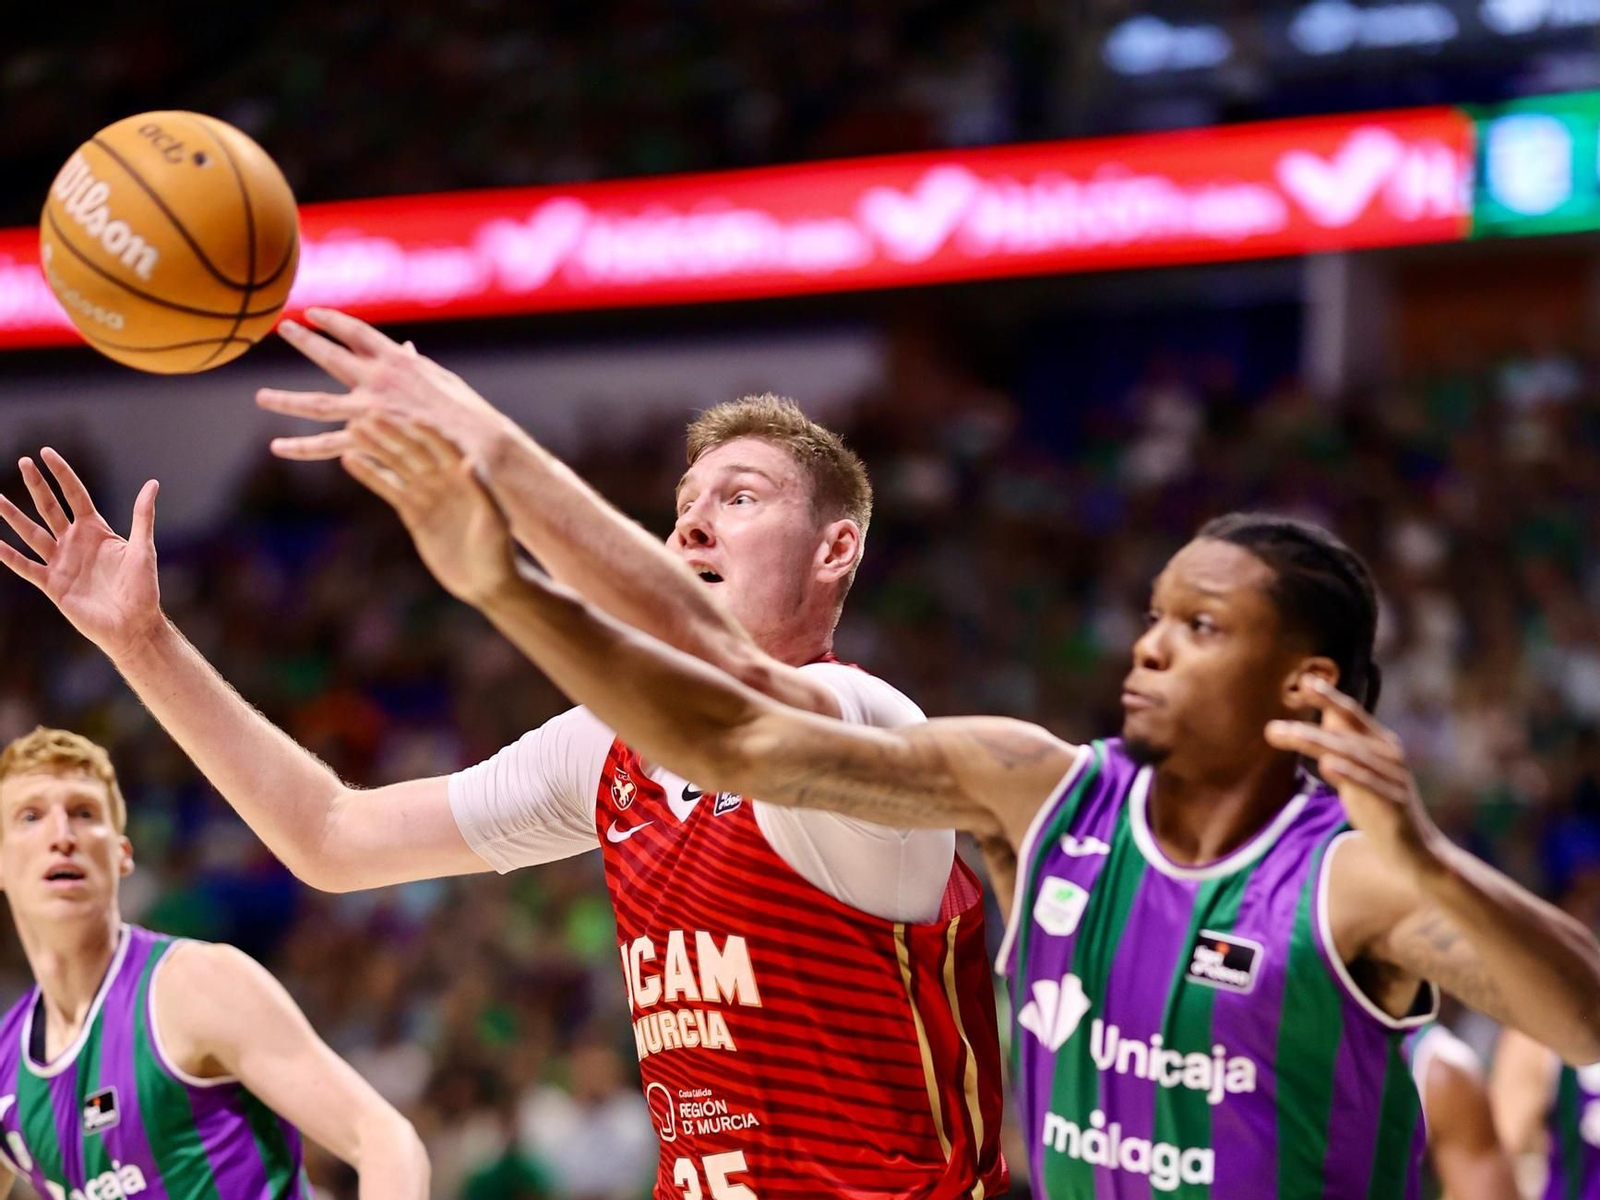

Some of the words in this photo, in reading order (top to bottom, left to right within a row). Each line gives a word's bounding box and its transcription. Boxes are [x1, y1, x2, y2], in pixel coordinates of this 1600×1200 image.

[50, 150, 160, 281] Wilson
[1090, 1019, 1256, 1104] Unicaja
[680, 1097, 728, 1118] REGIÓN
[696, 1112, 760, 1135] MURCIA
